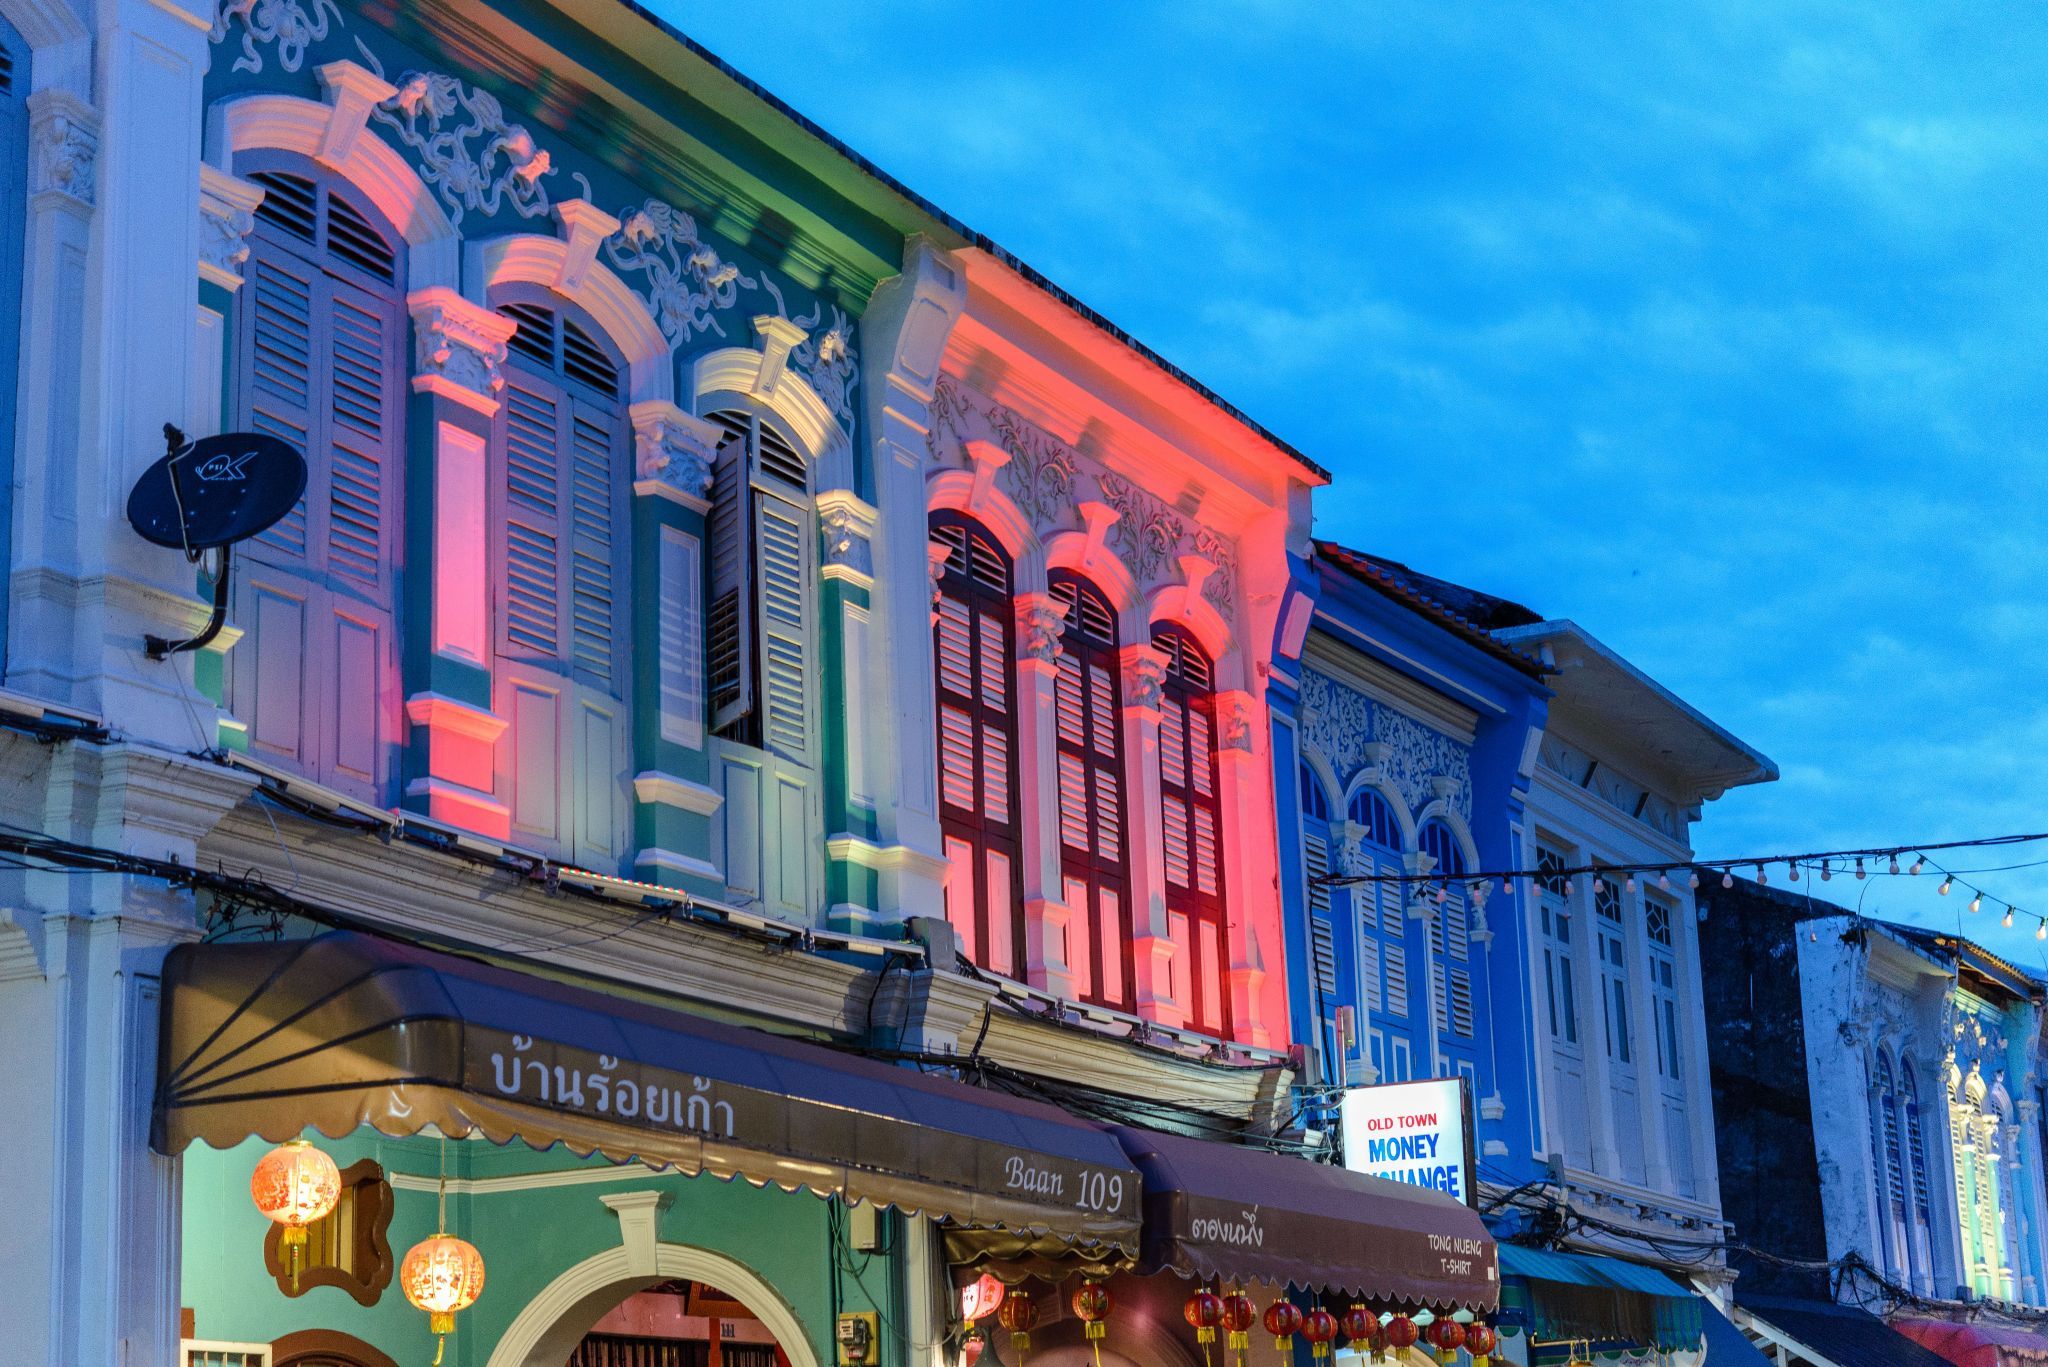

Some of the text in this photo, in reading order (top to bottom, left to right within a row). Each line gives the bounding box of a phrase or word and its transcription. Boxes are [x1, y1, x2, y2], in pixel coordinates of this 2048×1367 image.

[491, 1034, 734, 1137] บ้านร้อยเก้า
[1367, 1113, 1437, 1131] OLD TOWN
[1368, 1133, 1440, 1163] MONEY
[1005, 1156, 1123, 1213] Baan 109
[1372, 1165, 1460, 1198] ANGE
[1192, 1203, 1264, 1248] ตองหนึ่ง
[1427, 1234, 1482, 1258] TONG NUENG
[1440, 1258, 1472, 1276] T-SHIRT
